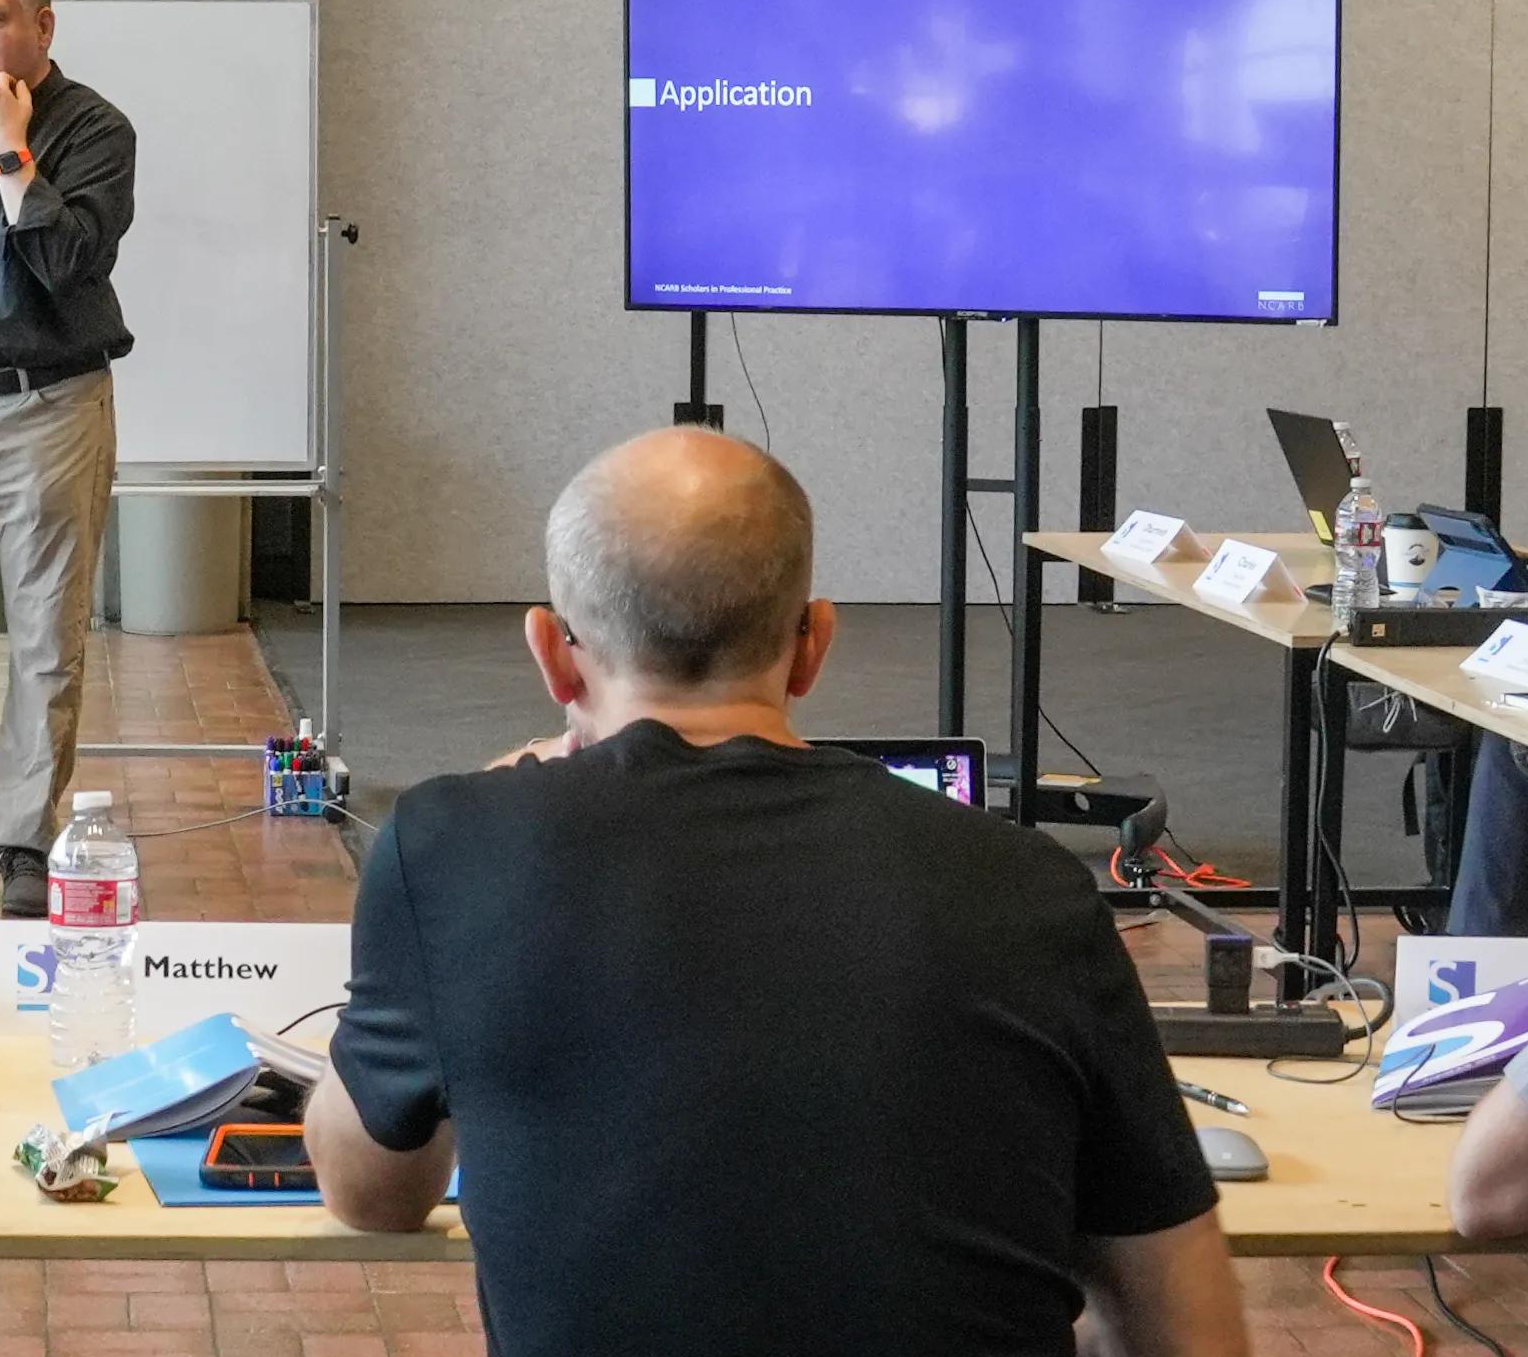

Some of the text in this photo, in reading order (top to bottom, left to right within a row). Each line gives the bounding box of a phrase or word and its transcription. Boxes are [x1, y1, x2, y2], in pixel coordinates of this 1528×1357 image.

[659, 79, 812, 111] Application
[655, 283, 679, 292] NCARB
[680, 283, 709, 293] Scholars
[719, 284, 762, 294] Professional
[763, 285, 792, 294] Practice
[1258, 300, 1304, 311] NCARB
[145, 955, 278, 980] Matthew
